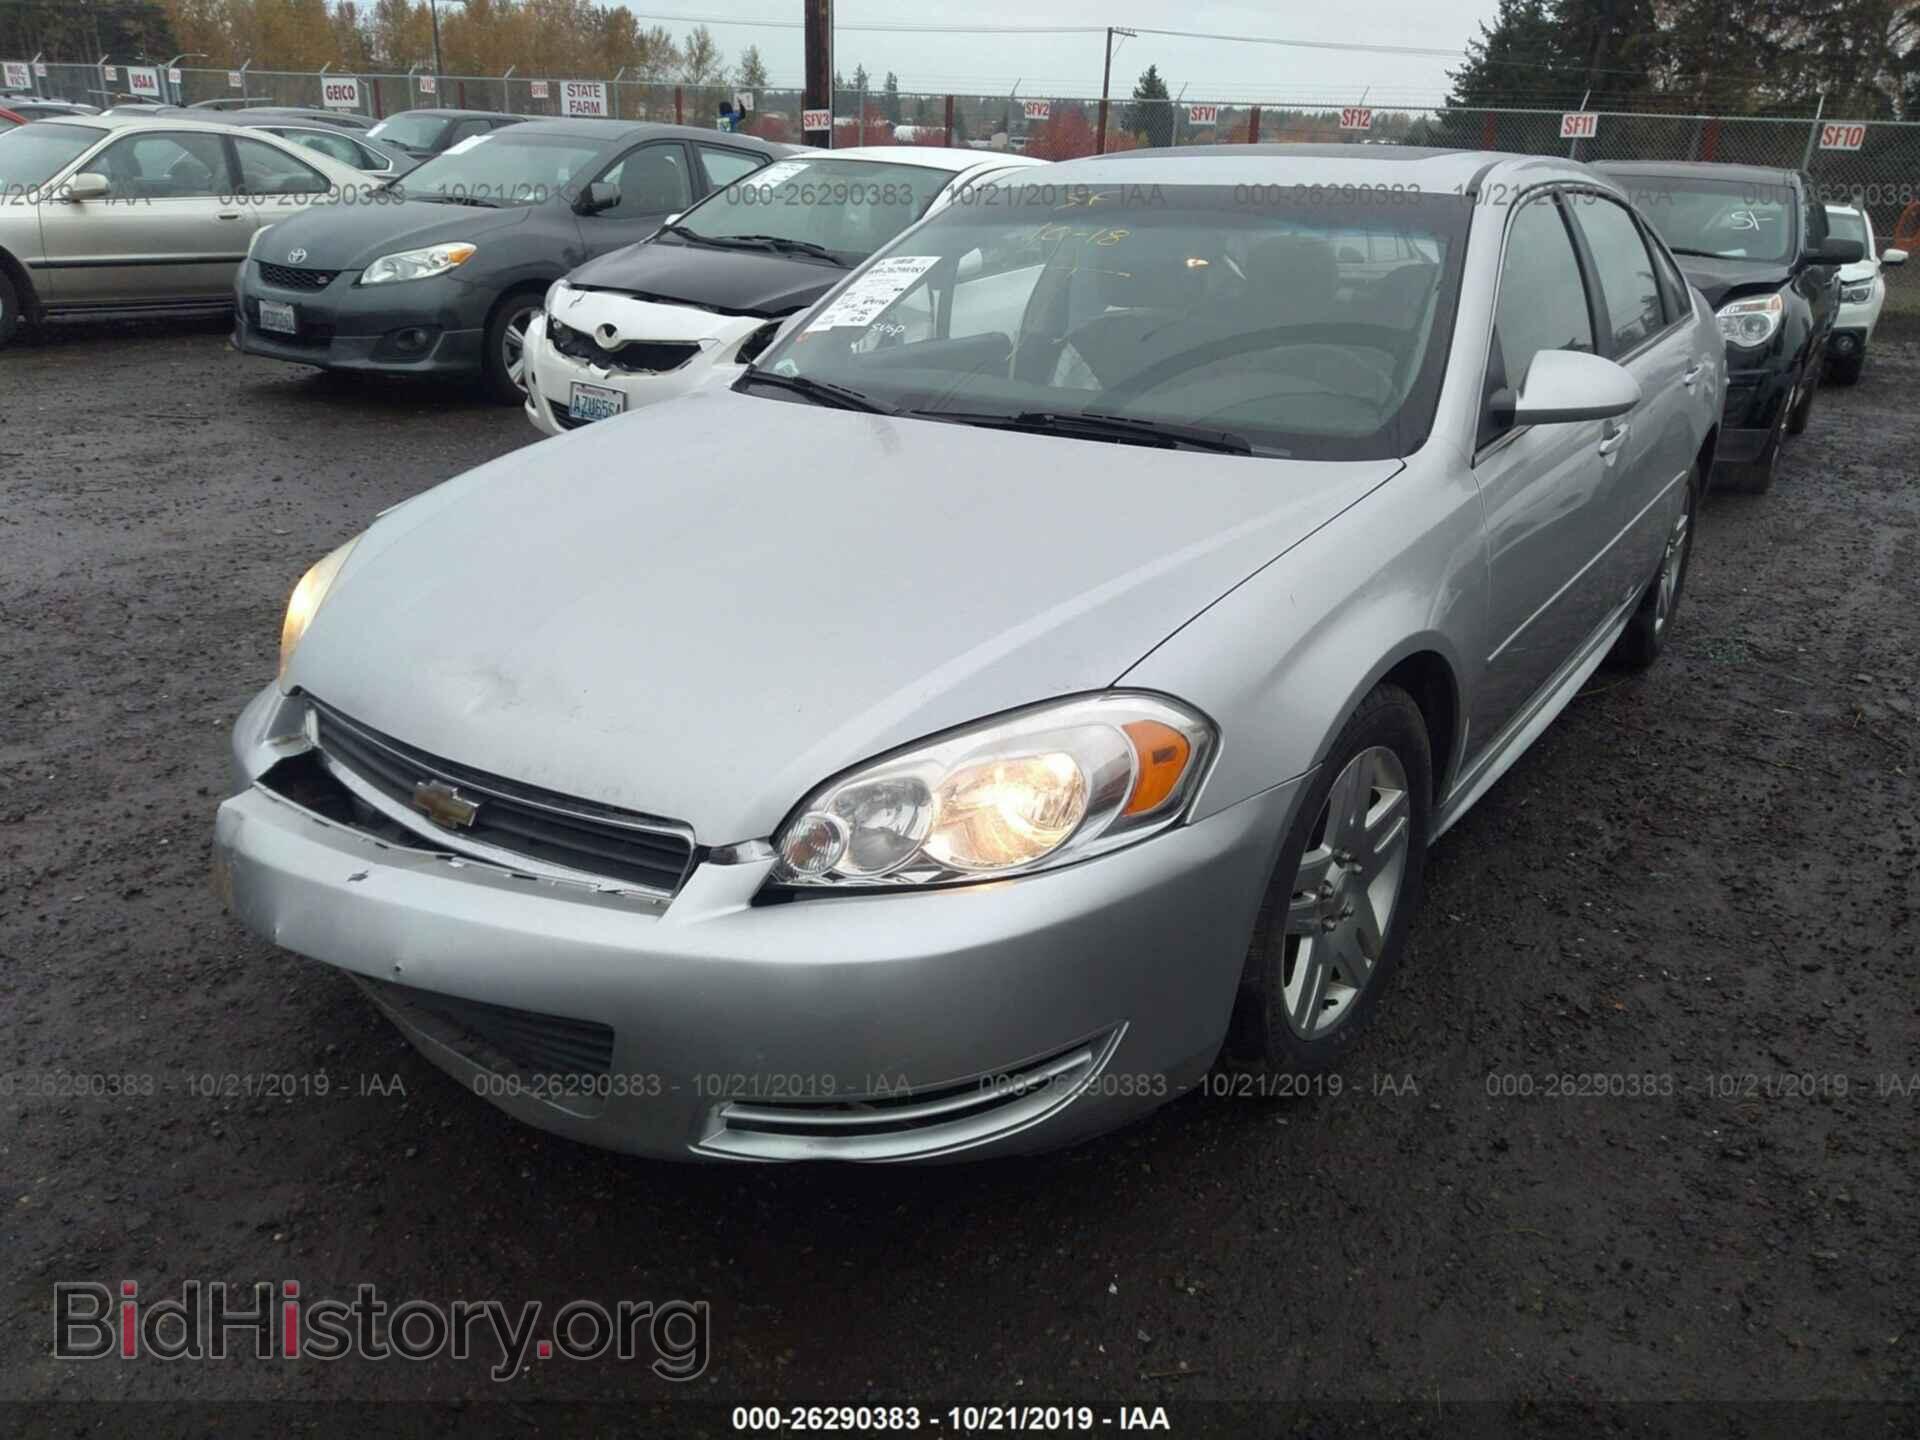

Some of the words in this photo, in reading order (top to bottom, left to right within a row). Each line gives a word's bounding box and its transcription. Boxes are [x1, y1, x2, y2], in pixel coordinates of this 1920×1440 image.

[131, 74, 155, 88] USAA
[326, 84, 355, 100] GEICO
[567, 83, 601, 97] STATE
[569, 100, 600, 113] FARM
[1026, 102, 1049, 116] SFV2
[1191, 105, 1215, 121] SFV1
[804, 112, 830, 128] SFV3
[1342, 108, 1370, 127] SF12
[1564, 115, 1594, 135] SF11
[1823, 125, 1863, 146] SF10
